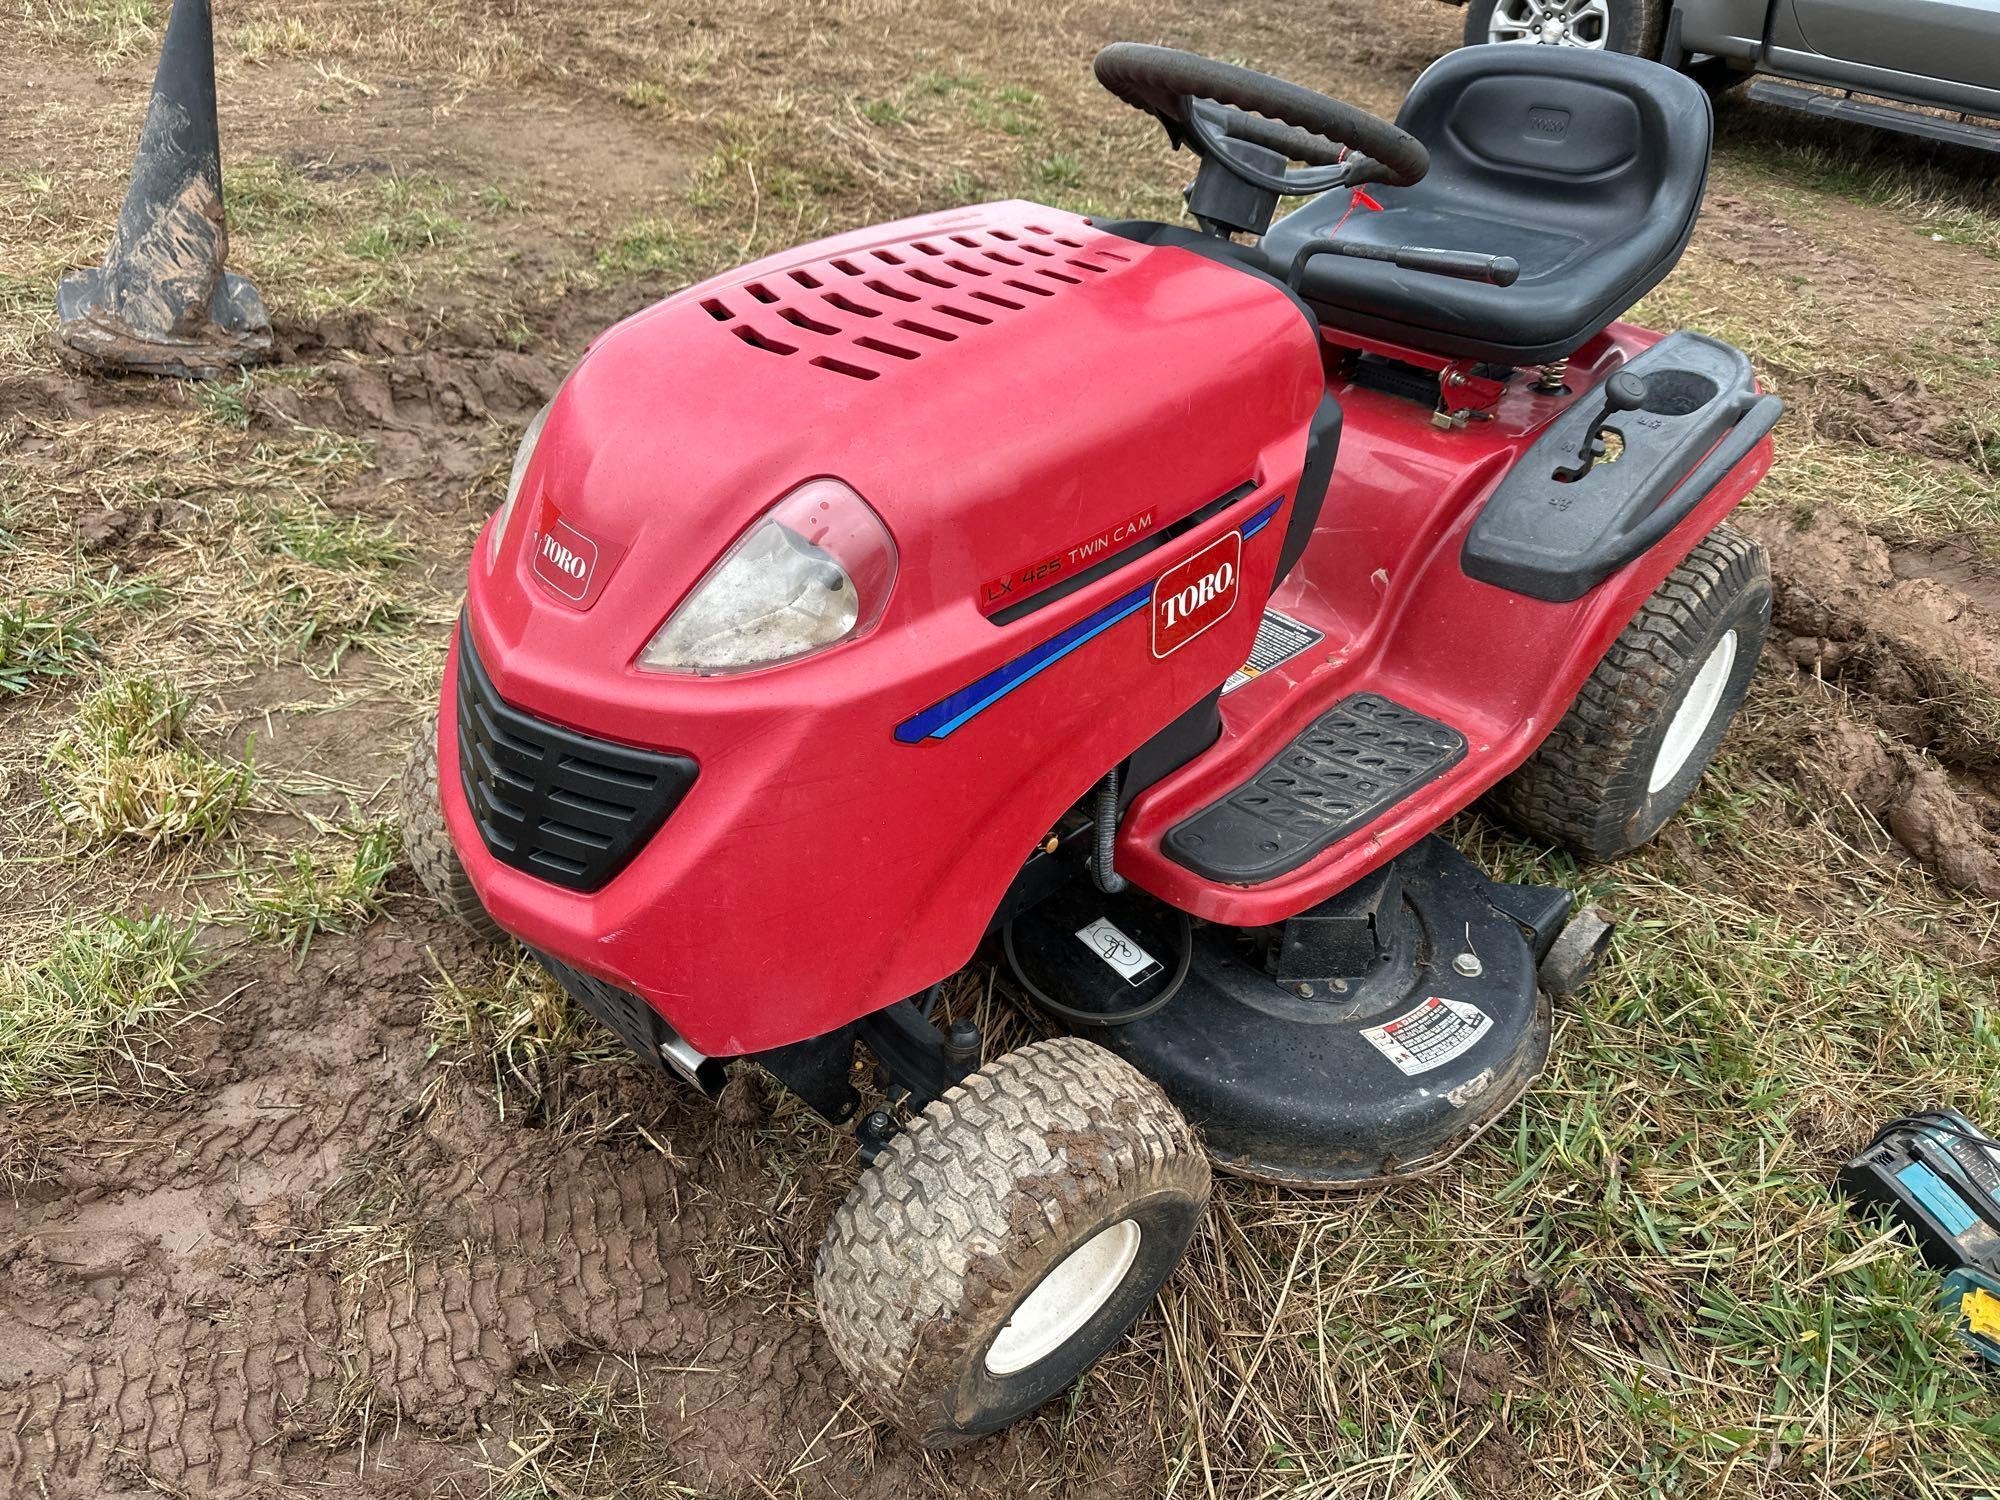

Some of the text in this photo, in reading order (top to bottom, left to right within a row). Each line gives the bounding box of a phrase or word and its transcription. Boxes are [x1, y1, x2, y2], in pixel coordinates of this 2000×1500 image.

[542, 533, 586, 579] TORO
[987, 512, 1153, 602] LX 425 TWIN CAM
[1161, 562, 1233, 630] TORO
[1402, 1005, 1432, 1027] DANGER
